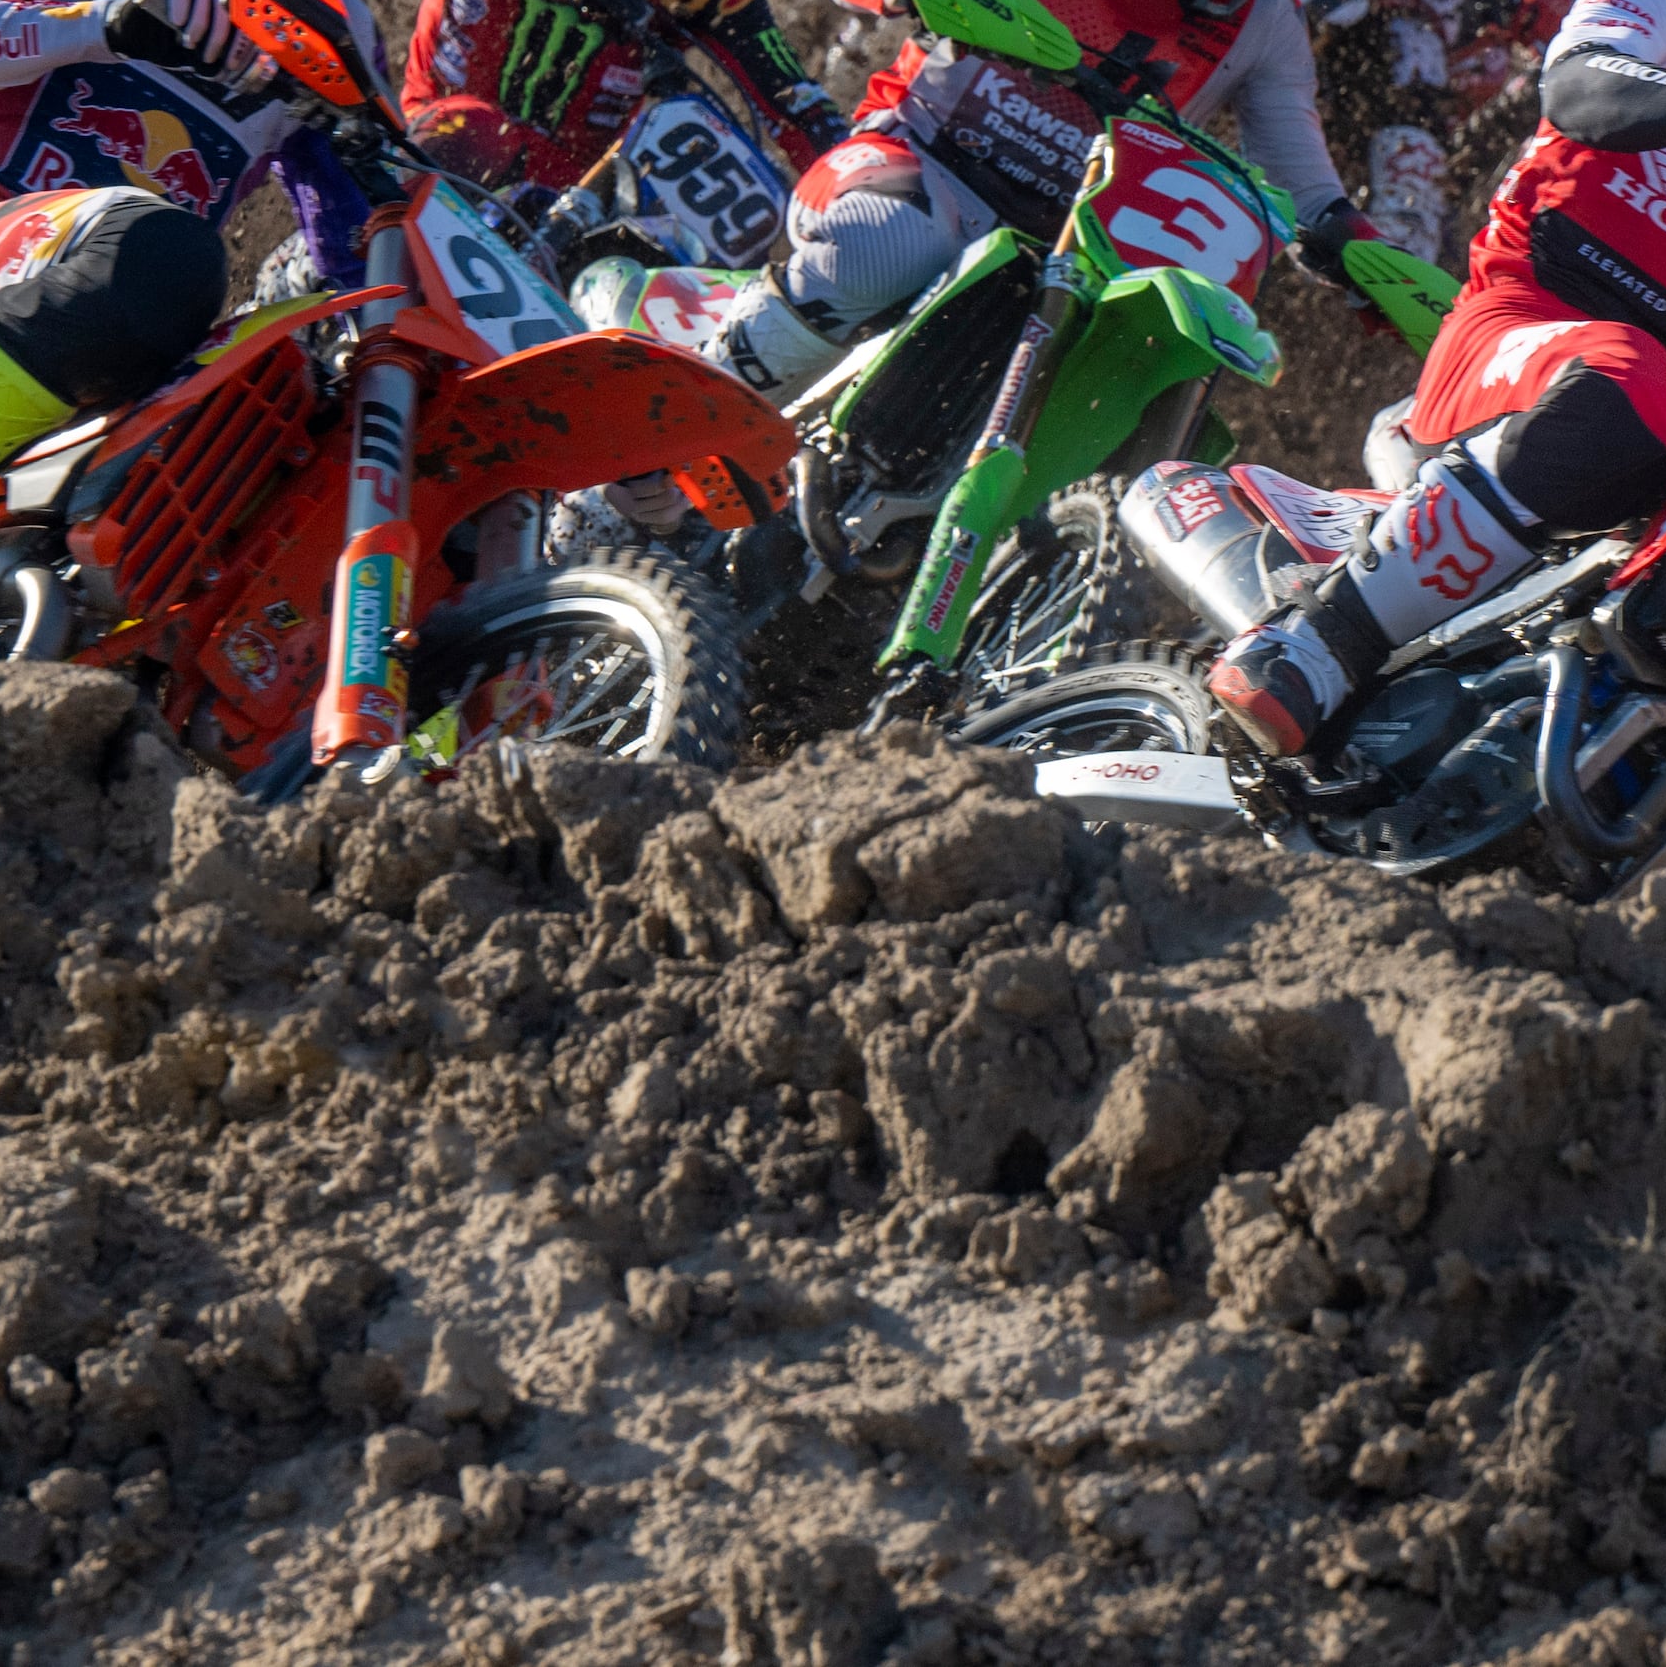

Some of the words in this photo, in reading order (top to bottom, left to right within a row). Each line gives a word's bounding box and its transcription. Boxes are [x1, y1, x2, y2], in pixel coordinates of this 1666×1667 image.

[983, 109, 1060, 166] Racing
[995, 154, 1038, 187] SHIP
[1036, 180, 1061, 199] TO
[637, 121, 779, 257] 959
[1108, 166, 1263, 284] 3
[352, 588, 383, 677] MOTOREX
